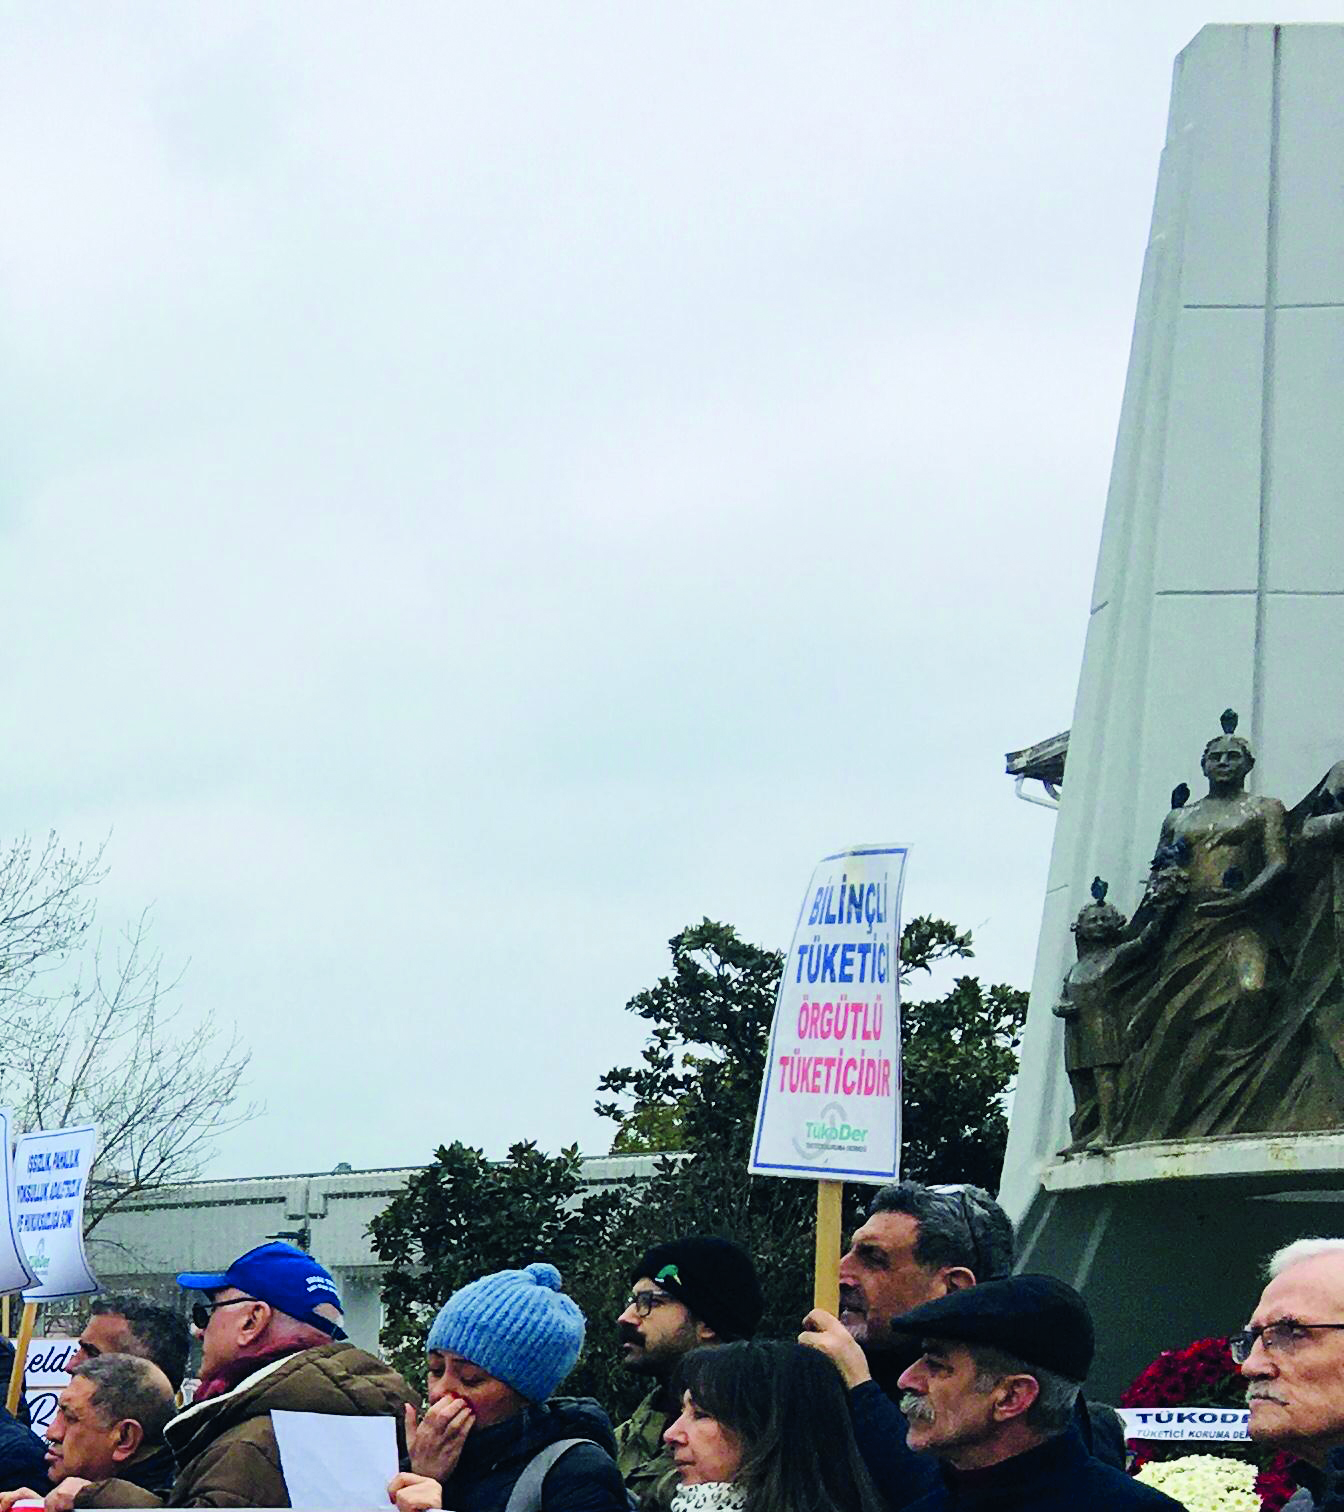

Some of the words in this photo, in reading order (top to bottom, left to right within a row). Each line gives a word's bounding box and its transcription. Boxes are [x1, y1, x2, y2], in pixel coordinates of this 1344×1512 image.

[807, 873, 888, 934] BİLİNÇLİ
[795, 933, 890, 984] TÜKETİCİ
[797, 994, 884, 1041] ÖRGÜTLÜ
[779, 1048, 891, 1097] TÜKETİCİDİR
[1188, 1429, 1230, 1439] KORUMA
